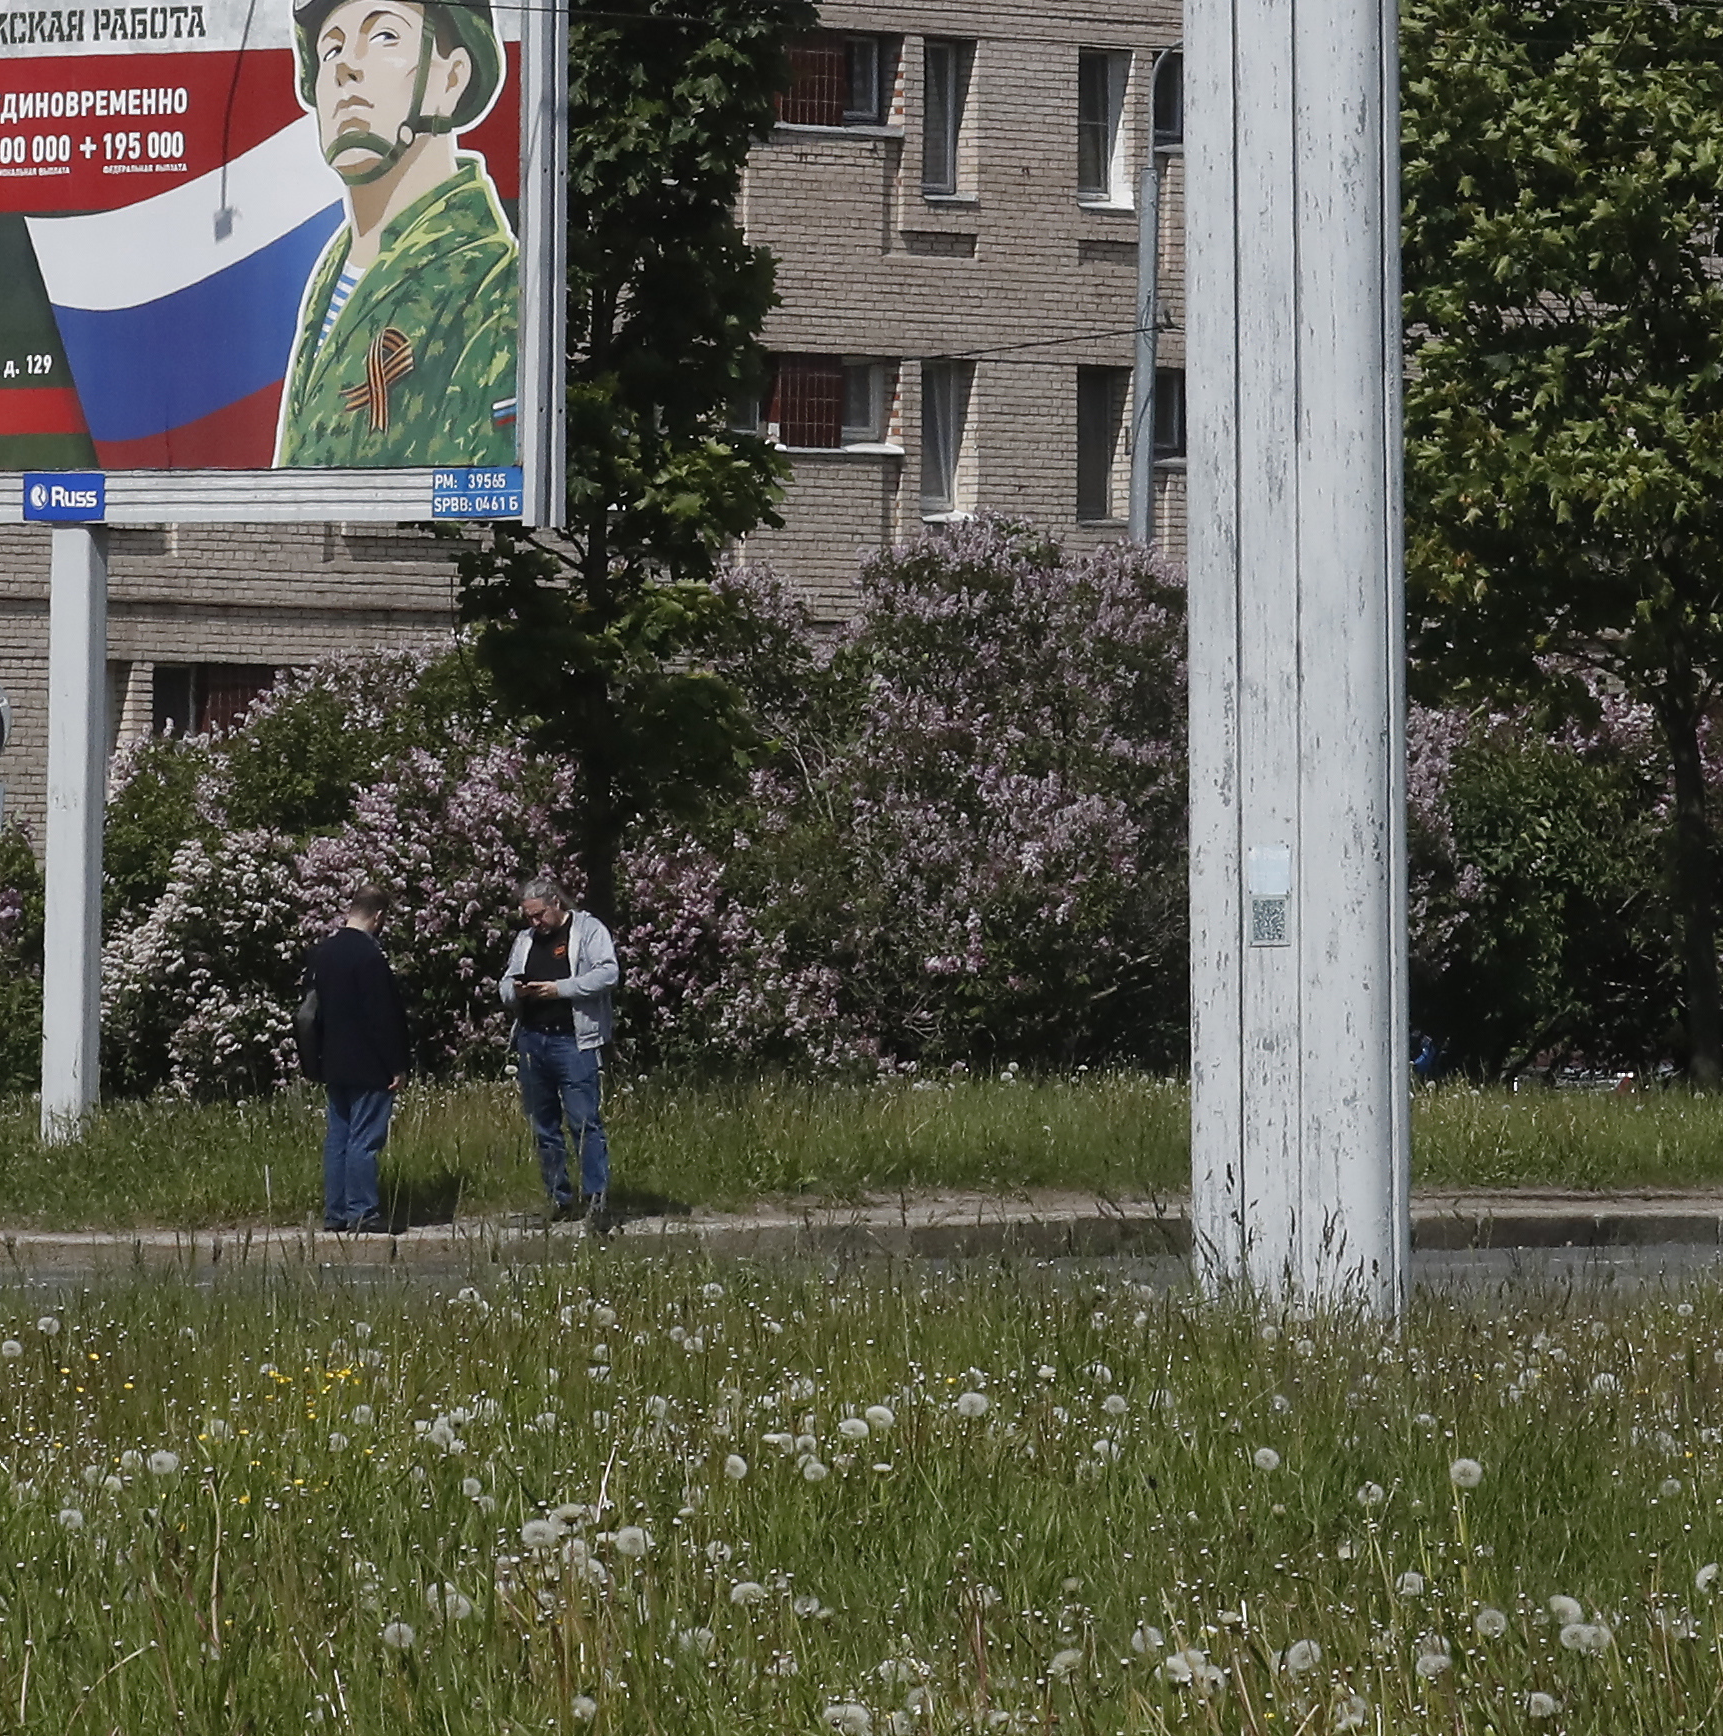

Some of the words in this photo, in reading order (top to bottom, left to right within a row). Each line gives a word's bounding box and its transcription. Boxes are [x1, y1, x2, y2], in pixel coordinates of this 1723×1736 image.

[92, 5, 207, 40] РАБОТА
[32, 134, 71, 163] 000
[103, 132, 141, 160] 195
[147, 131, 184, 159] 000
[3, 360, 20, 379] д.
[26, 355, 52, 375] 129
[468, 473, 506, 489] 39565
[51, 486, 97, 507] Russ
